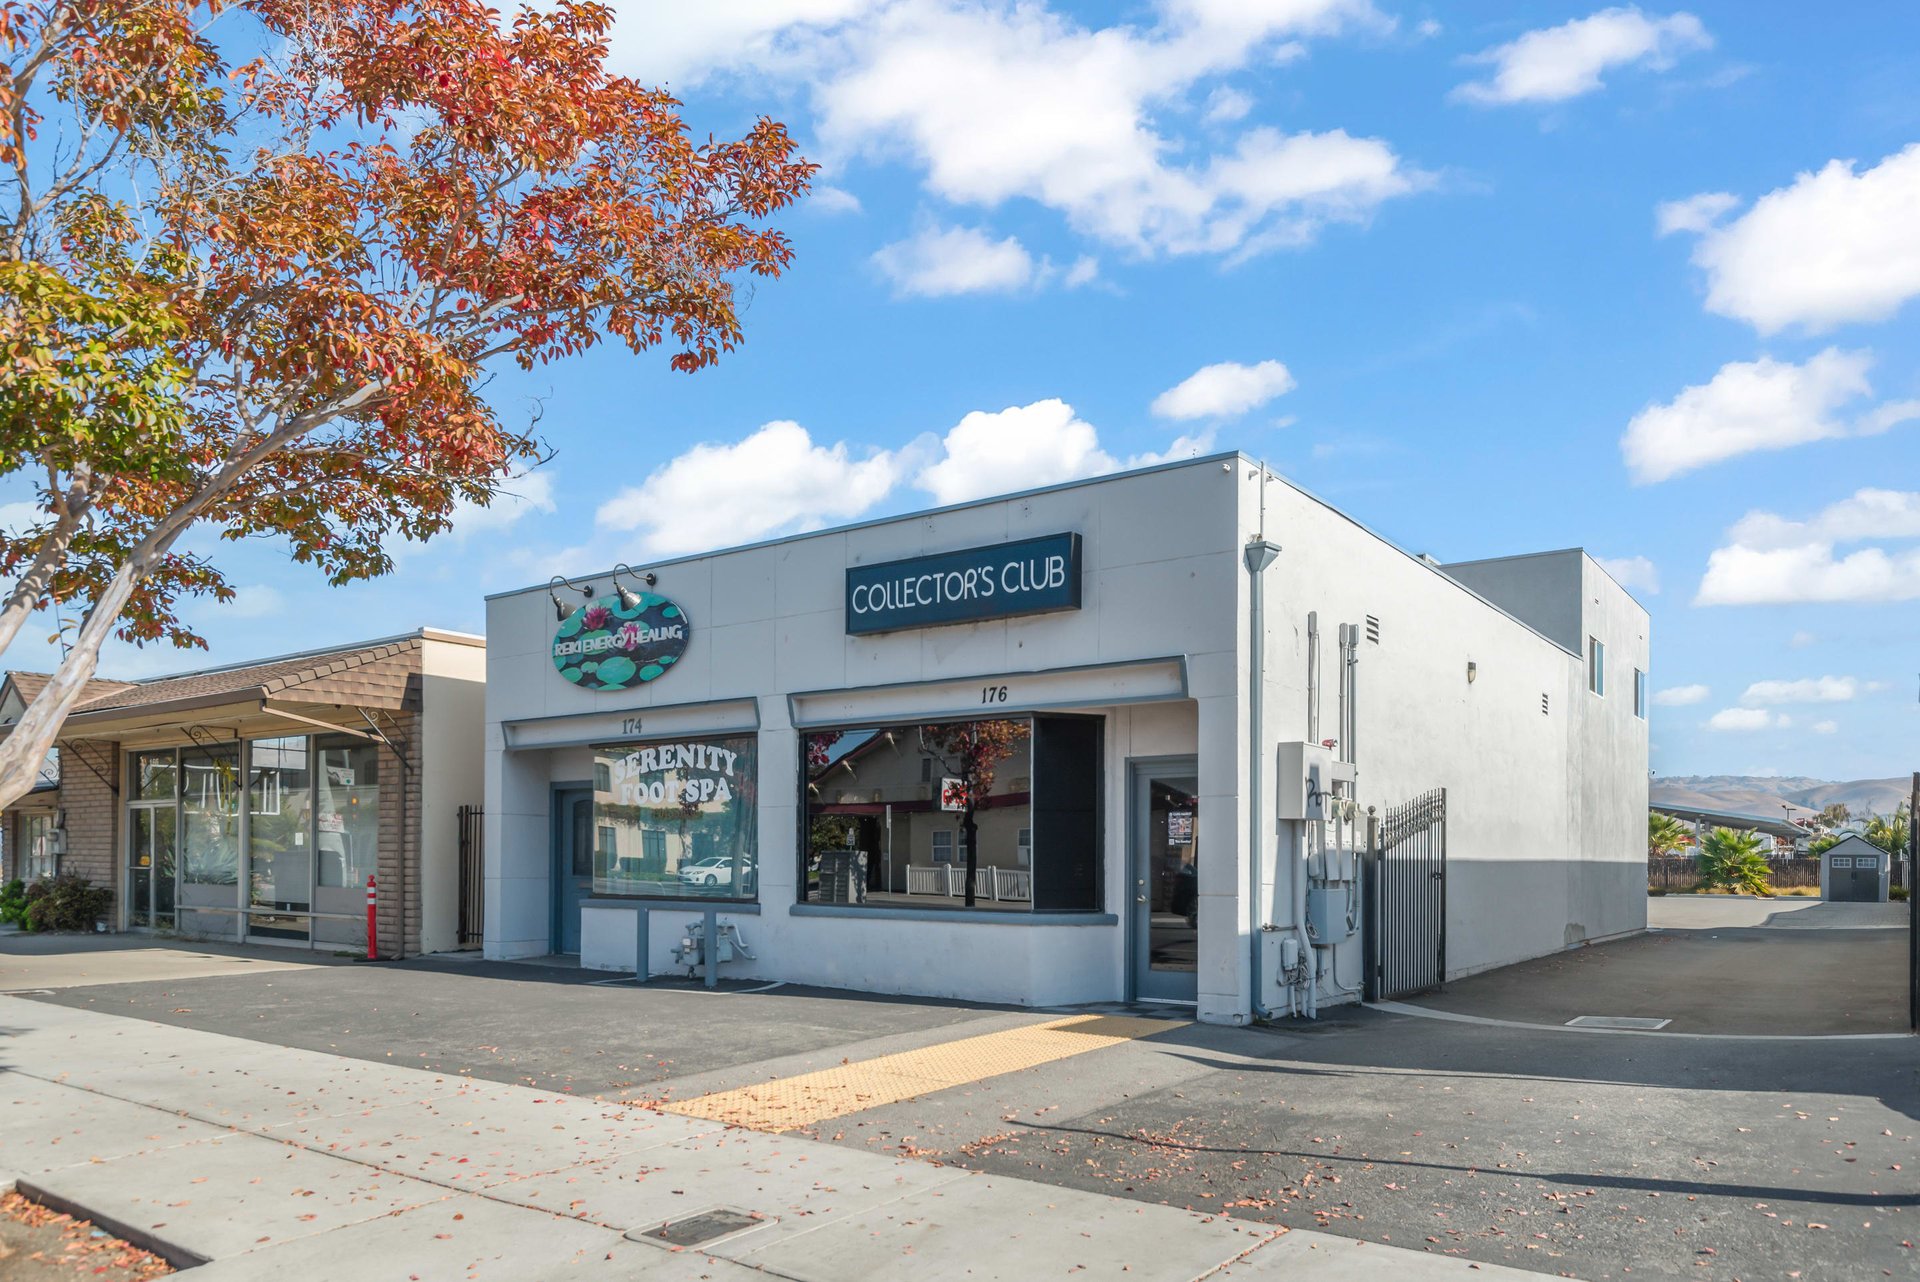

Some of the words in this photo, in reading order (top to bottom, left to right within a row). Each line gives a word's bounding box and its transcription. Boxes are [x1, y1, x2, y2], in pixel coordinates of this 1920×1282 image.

[852, 566, 995, 614] COLLECTOR'S
[1001, 555, 1065, 593] CLUB
[582, 632, 628, 653] ENERGY
[630, 624, 683, 644] HEALING
[981, 686, 1008, 704] 176
[622, 718, 642, 734] 174
[614, 744, 737, 784] SERENITY
[621, 781, 679, 806] FOOT
[685, 777, 733, 803] SPA
